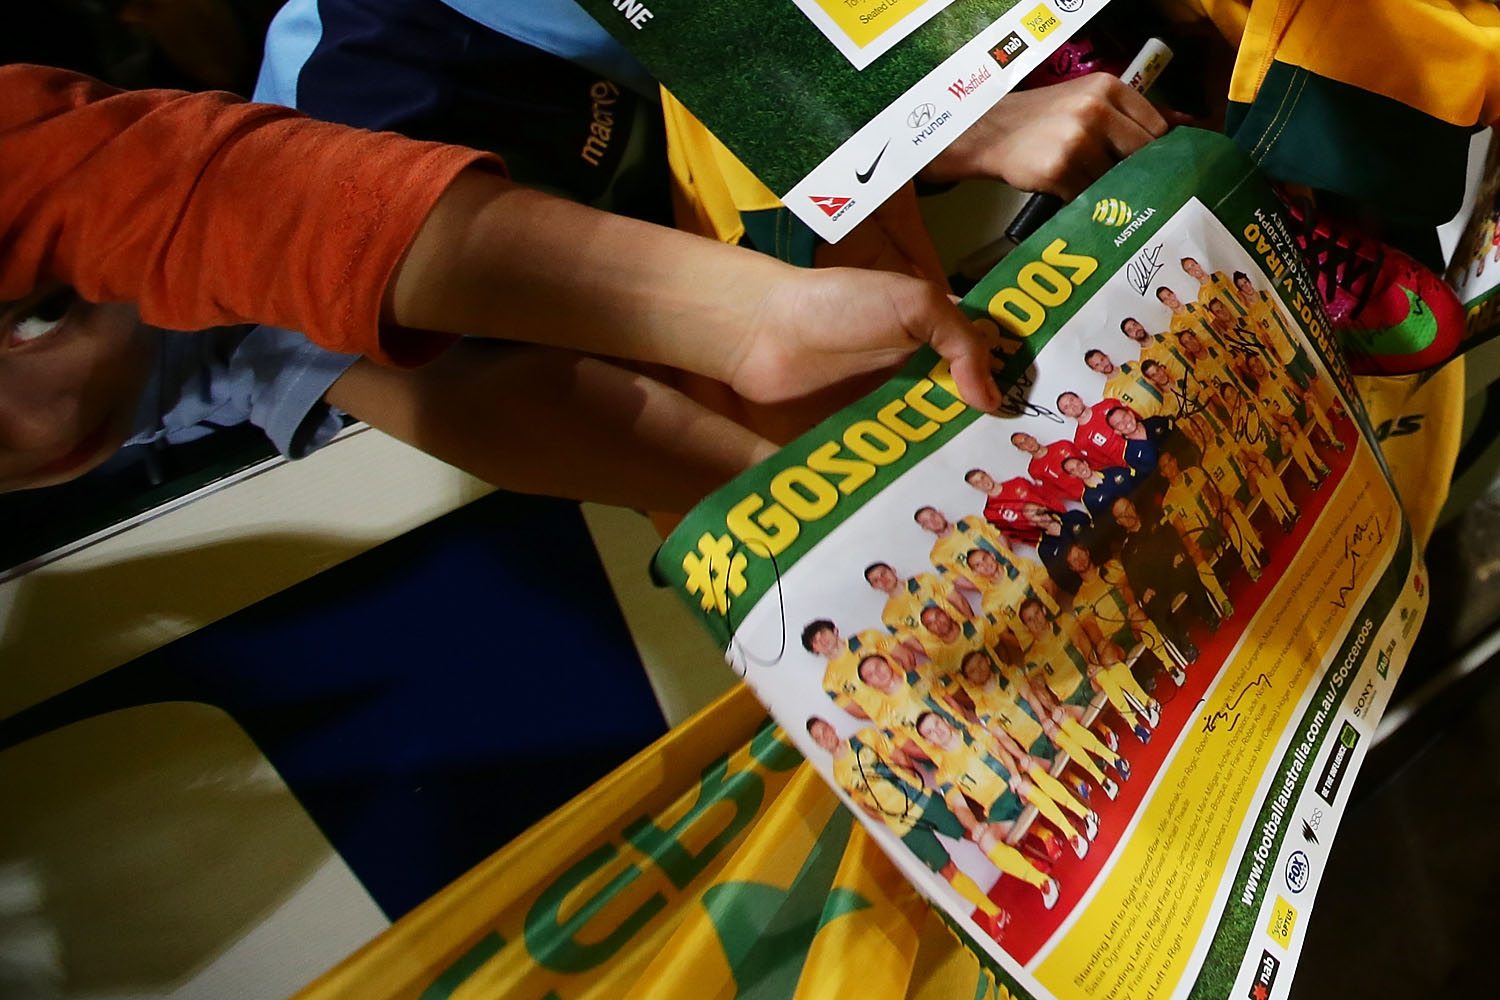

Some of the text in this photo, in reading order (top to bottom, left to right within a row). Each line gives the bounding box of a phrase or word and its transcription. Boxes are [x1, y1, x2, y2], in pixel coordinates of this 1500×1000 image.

[859, 3, 888, 25] Seated
[1038, 16, 1056, 33] OPTUS
[1003, 35, 1023, 55] nab
[948, 65, 992, 101] Westfield
[912, 110, 952, 146] HYUNDAI
[1113, 206, 1157, 248] AUSTRALIA
[1254, 208, 1289, 253] 7.30PM
[1244, 223, 1285, 278] IRAQ
[1353, 679, 1375, 718] SONY
[1242, 619, 1374, 906] www.footballaustralia.com.au/Socceroos
[1311, 808, 1323, 831] SBS
[1288, 858, 1305, 885] FOX
[1282, 908, 1294, 937] OPTUS
[1260, 956, 1275, 985] nab
